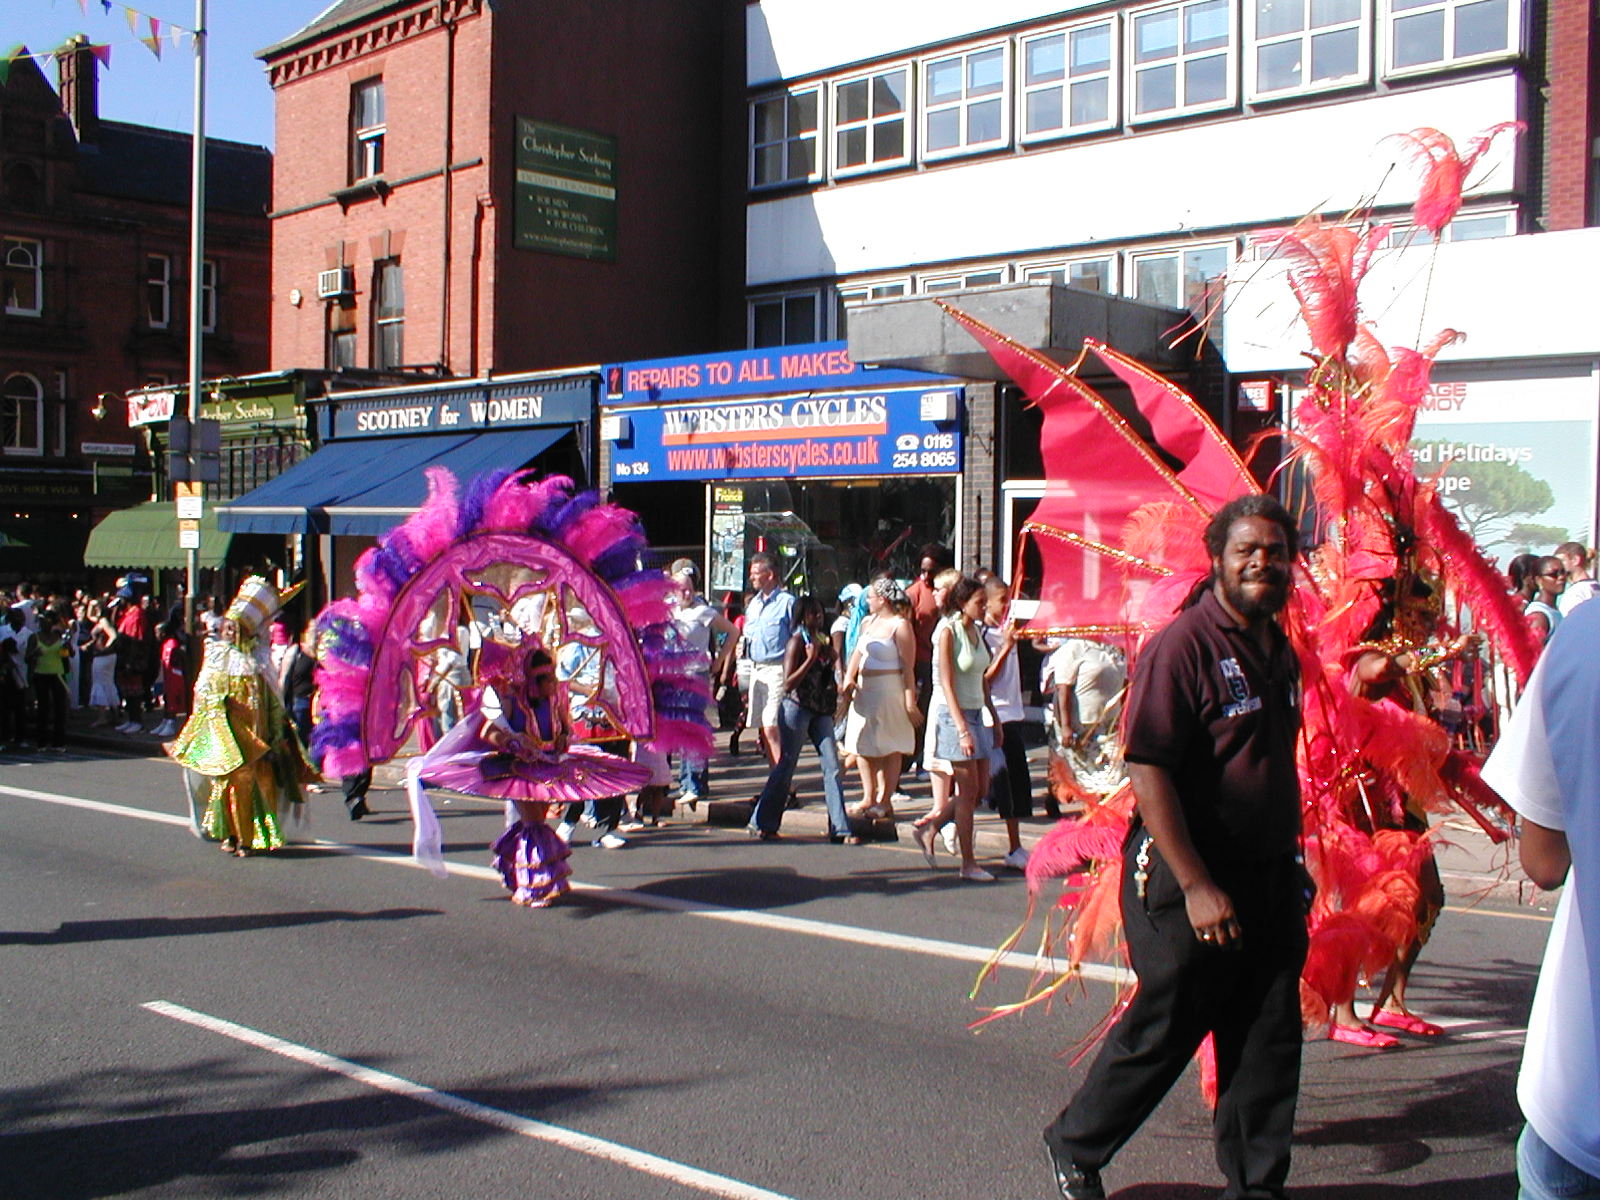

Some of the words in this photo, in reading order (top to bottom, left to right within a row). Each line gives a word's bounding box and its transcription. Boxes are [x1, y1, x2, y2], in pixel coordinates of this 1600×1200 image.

[628, 364, 701, 392] REPAIRS
[706, 361, 733, 385] TO
[738, 358, 775, 383] ALL
[781, 350, 856, 379] MAKES
[1425, 383, 1467, 397] AGE
[234, 400, 274, 420] Scotney
[357, 405, 434, 431] SCOTNEY
[440, 403, 460, 425] for
[470, 396, 543, 422] WOMEN
[664, 402, 784, 435] WEBSTERS
[790, 396, 887, 428] CYCLES
[667, 436, 879, 474] www.websterscycles.co.uk
[892, 453, 918, 468] 254
[920, 451, 956, 467] 8065
[1408, 443, 1433, 463] ed
[1438, 442, 1533, 467] Holidays
[616, 463, 631, 476] No
[631, 462, 649, 475] 134
